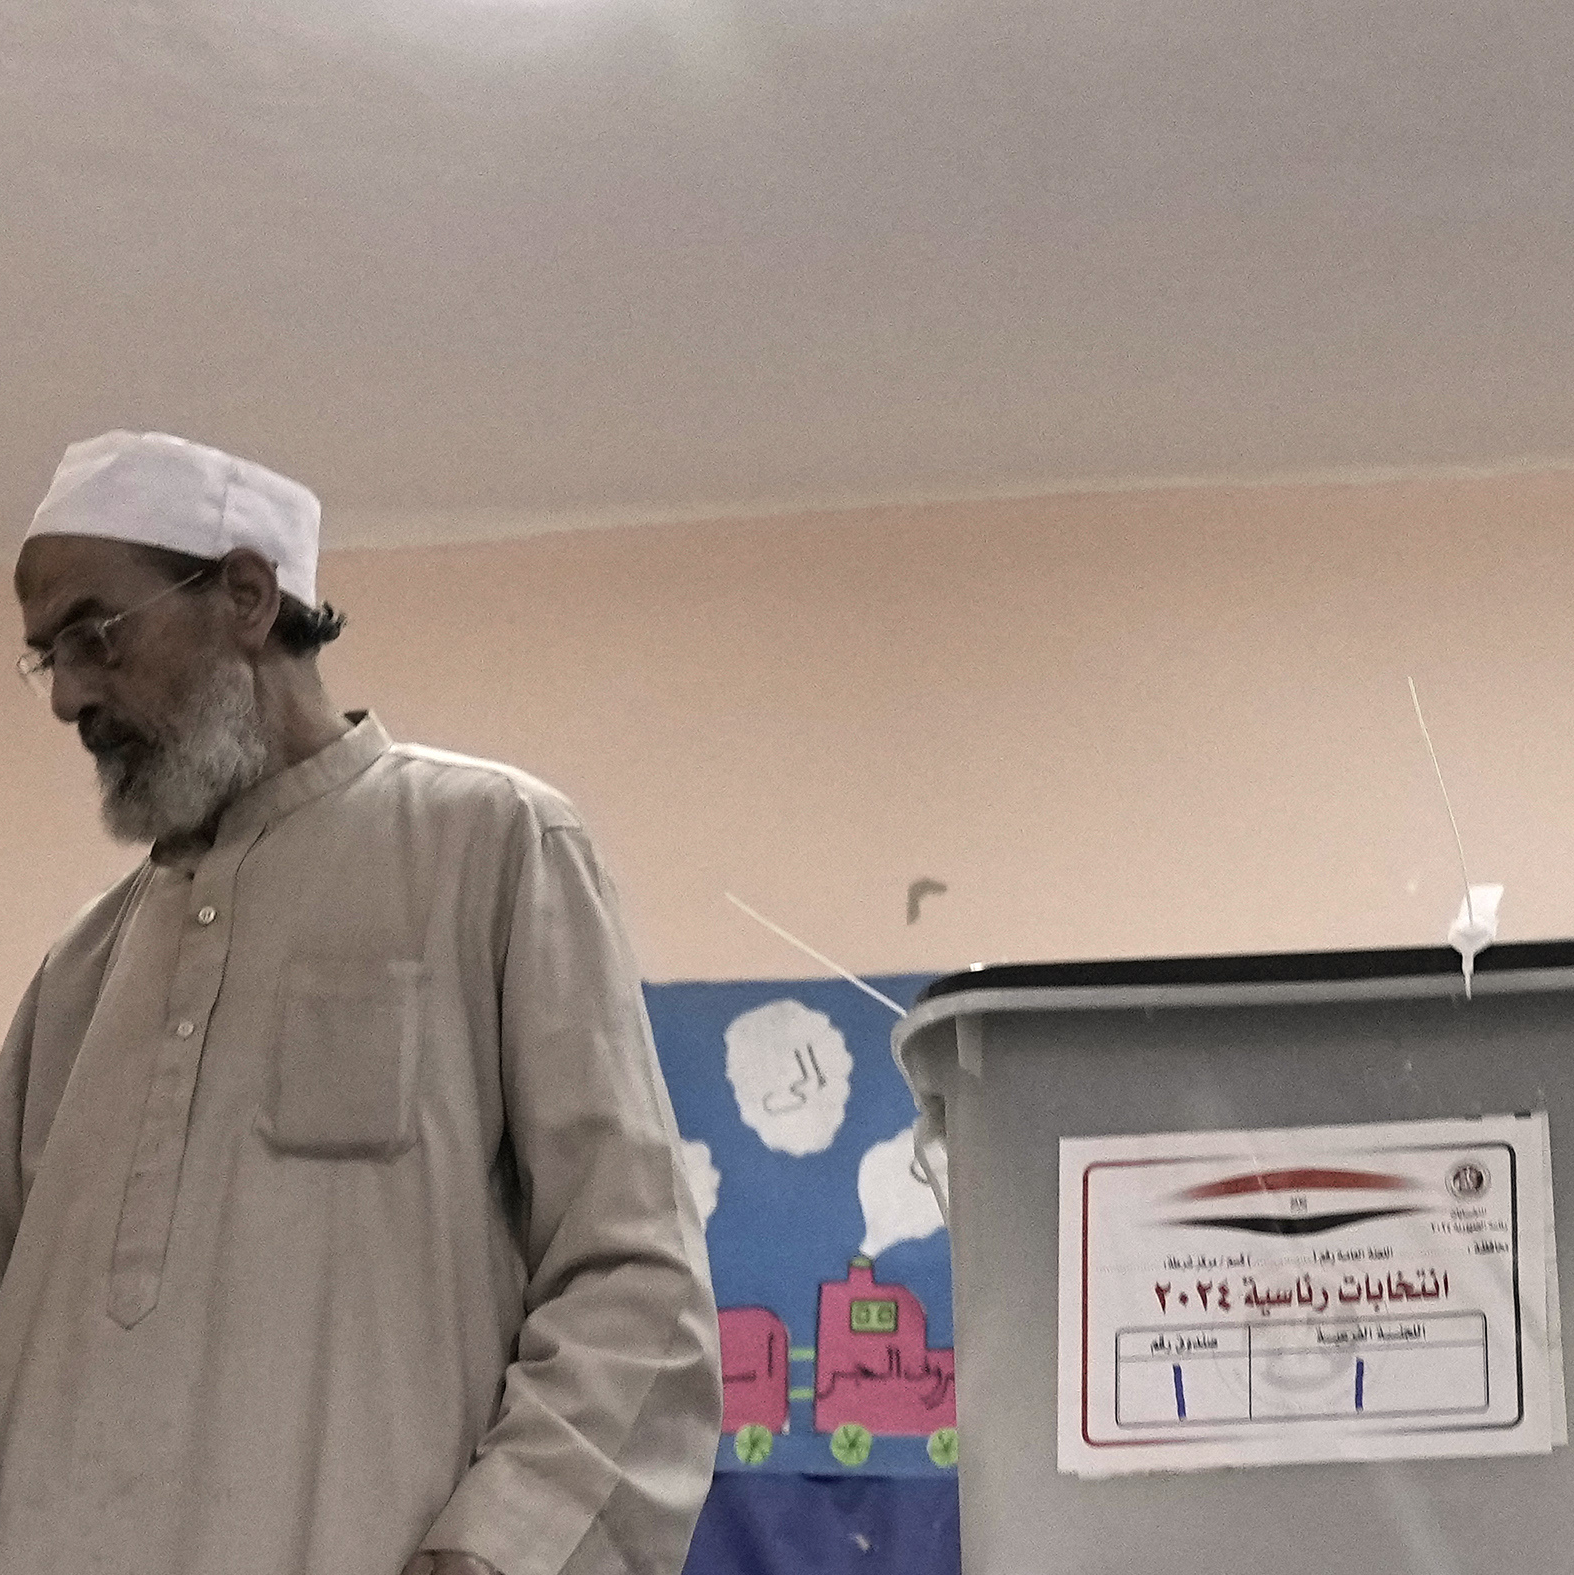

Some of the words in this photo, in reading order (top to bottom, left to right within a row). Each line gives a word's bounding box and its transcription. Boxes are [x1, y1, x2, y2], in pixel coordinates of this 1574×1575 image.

[1154, 1279, 1231, 1316] ٢٠٢٤
[1244, 1272, 1330, 1317] رئاسية
[1338, 1267, 1450, 1313] انتخابات
